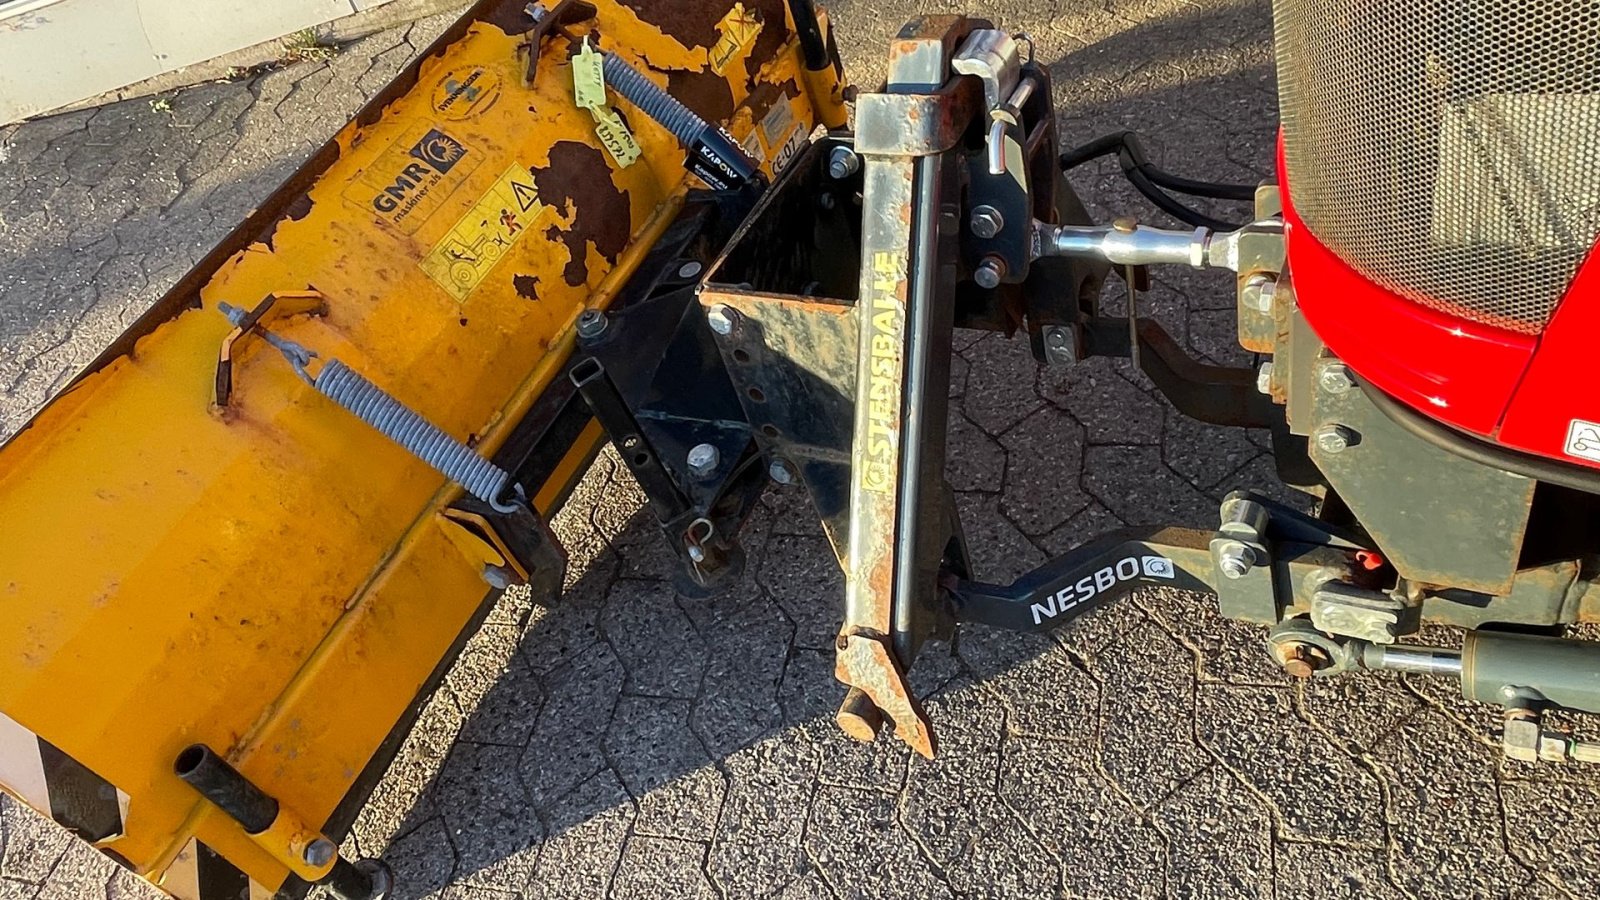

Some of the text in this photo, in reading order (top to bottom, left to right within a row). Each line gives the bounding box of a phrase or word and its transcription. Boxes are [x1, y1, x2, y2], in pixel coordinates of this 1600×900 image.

[700, 145, 738, 178] KAPOW
[373, 162, 431, 213] GMR
[393, 172, 442, 223] maskiner a/s
[1030, 556, 1140, 625] NESBO
